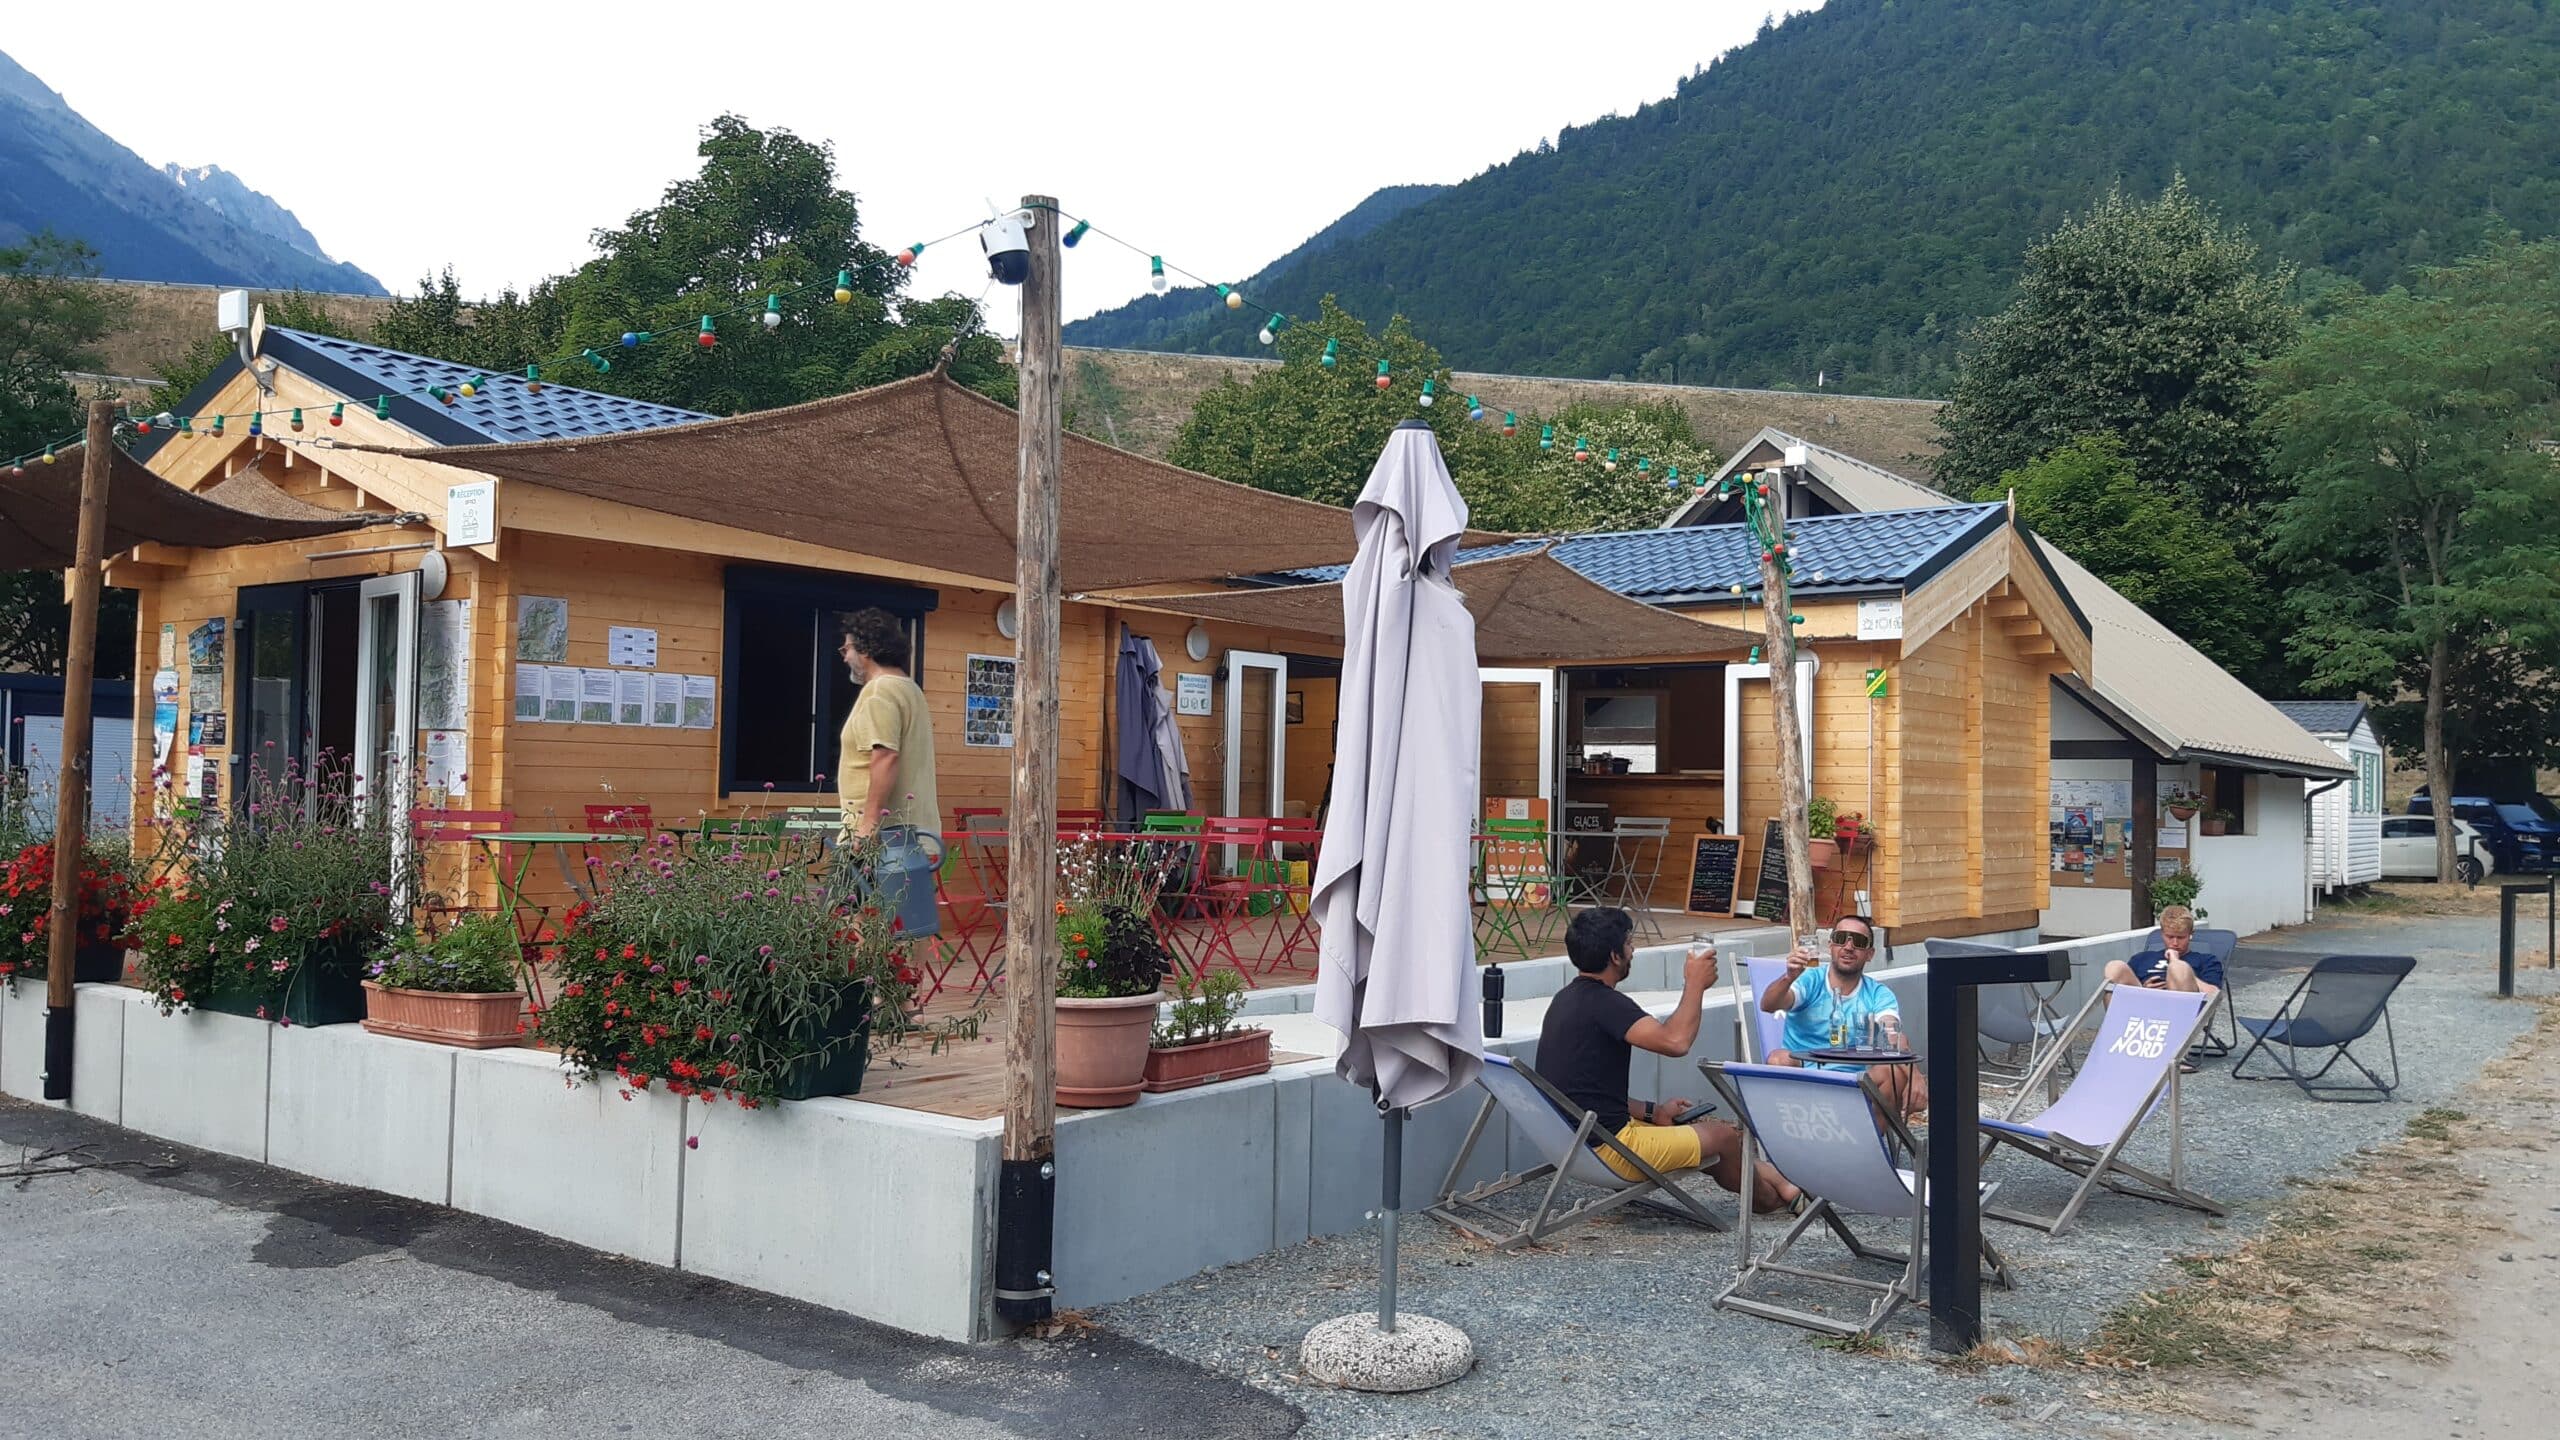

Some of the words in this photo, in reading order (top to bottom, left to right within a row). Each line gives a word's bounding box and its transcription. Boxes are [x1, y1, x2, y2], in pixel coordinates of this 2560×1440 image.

[1866, 672, 1876, 680] PR
[1573, 815, 1600, 828] GLACES
[2123, 1019, 2169, 1042] FACE
[2109, 1036, 2164, 1058] NORD
